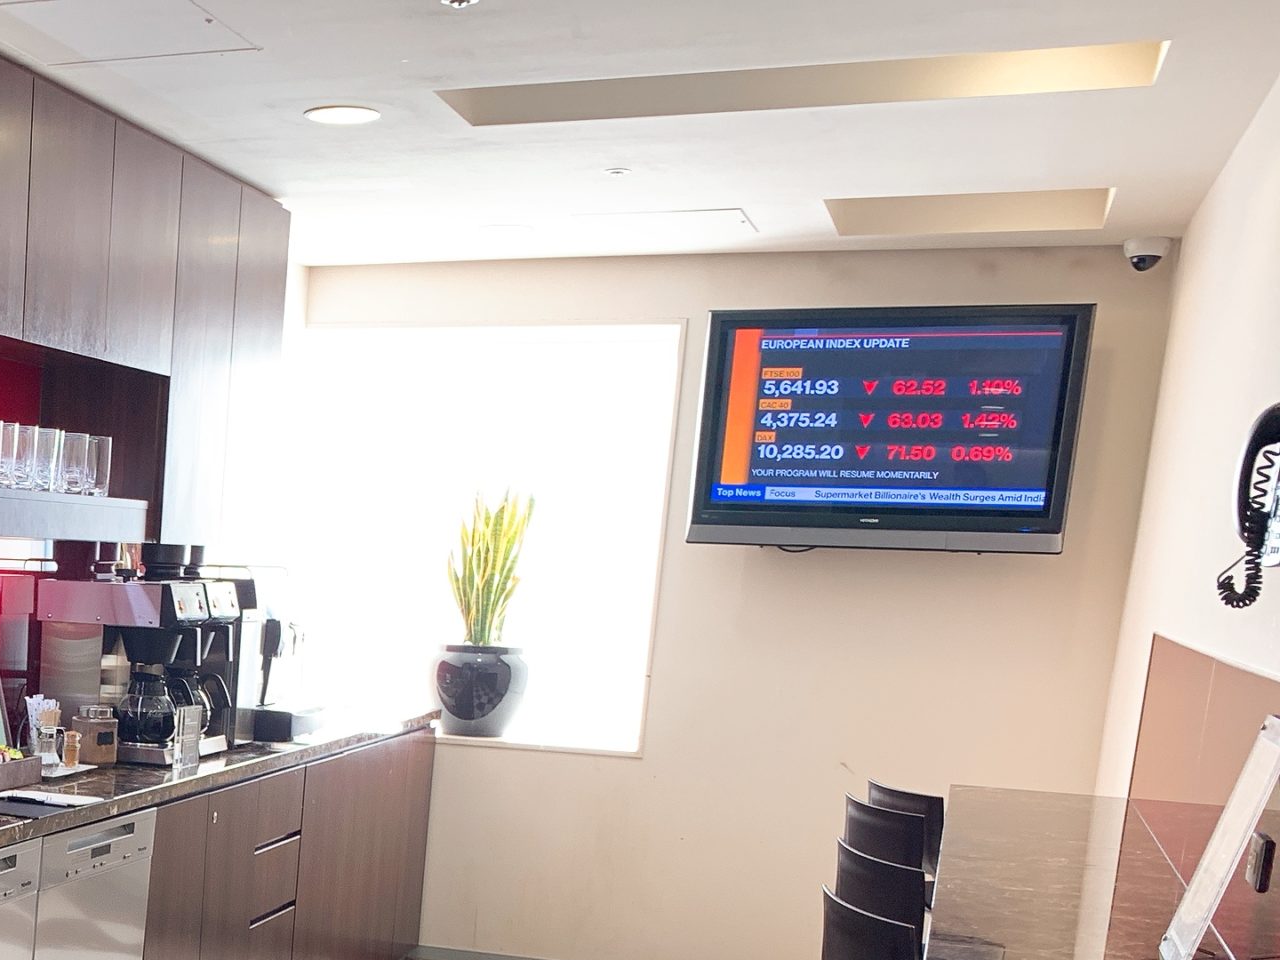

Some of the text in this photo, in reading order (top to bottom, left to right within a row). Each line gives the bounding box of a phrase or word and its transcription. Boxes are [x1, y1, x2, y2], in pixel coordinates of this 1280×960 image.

[761, 338, 910, 349] EUROPEAN INDEX UPDATE
[786, 370, 800, 378] 100
[763, 379, 839, 397] 5,641.93
[892, 379, 946, 395] 62.52
[760, 412, 837, 429] 4,375.24
[887, 412, 943, 428] 63.03
[757, 444, 1013, 461] 10,285.20 71.50 0.69%
[751, 469, 939, 479] YOUR PROGRAM WILL RESUME MOMENTARILY
[717, 487, 761, 496] Top News
[770, 489, 796, 498] Focus
[814, 490, 873, 500] Supermarket
[874, 491, 926, 500] Billionaire's
[929, 492, 961, 501] Wealth
[962, 493, 996, 503] Surges
[997, 493, 1023, 502] Amid
